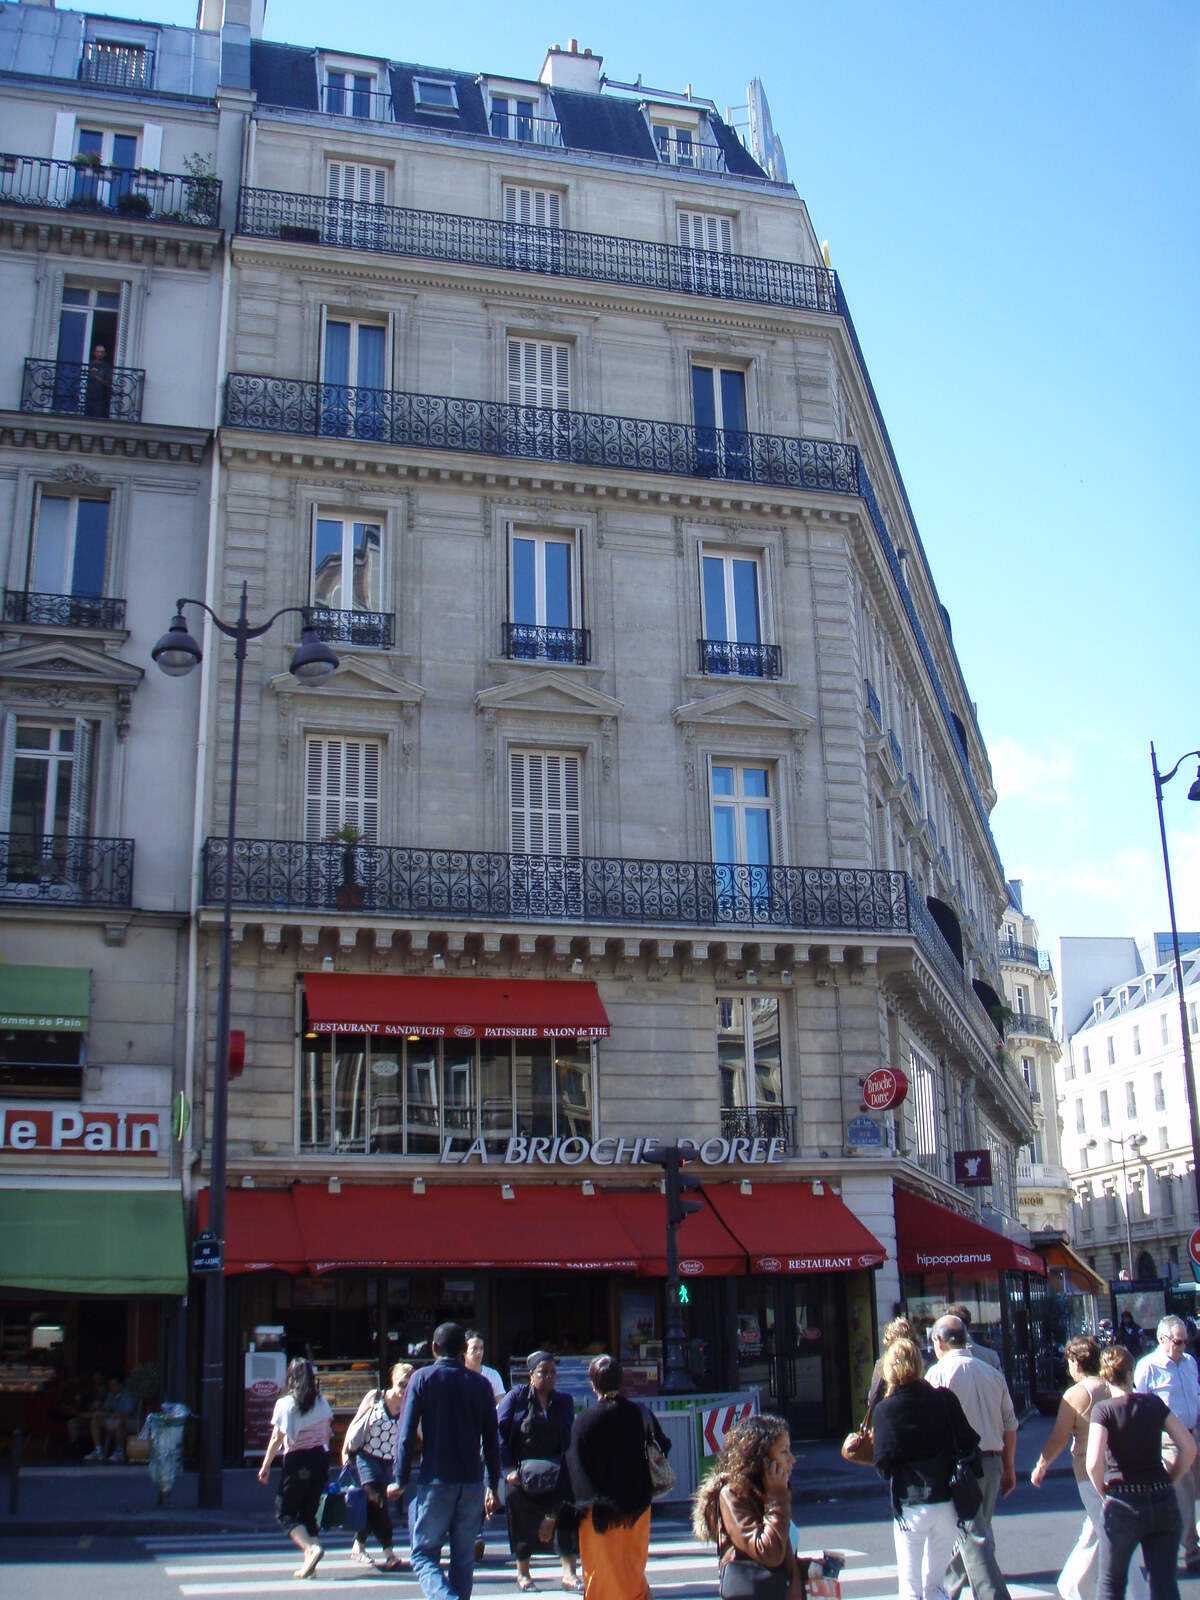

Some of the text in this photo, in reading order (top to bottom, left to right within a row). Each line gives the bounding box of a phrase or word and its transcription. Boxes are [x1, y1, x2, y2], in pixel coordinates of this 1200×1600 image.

[0, 1016, 81, 1028] omme de Pain
[312, 1022, 380, 1033] RESTAURANT
[385, 1024, 445, 1036] SANDWICHS
[484, 1026, 608, 1037] PATISSERIE SALON de THE
[867, 1073, 892, 1095] Brioche
[52, 1110, 159, 1152] Pain
[440, 1136, 488, 1164] LA
[504, 1136, 660, 1165] BRIOCHE
[788, 1257, 852, 1269] RESTAURANT
[916, 1252, 992, 1267] hippopotamus
